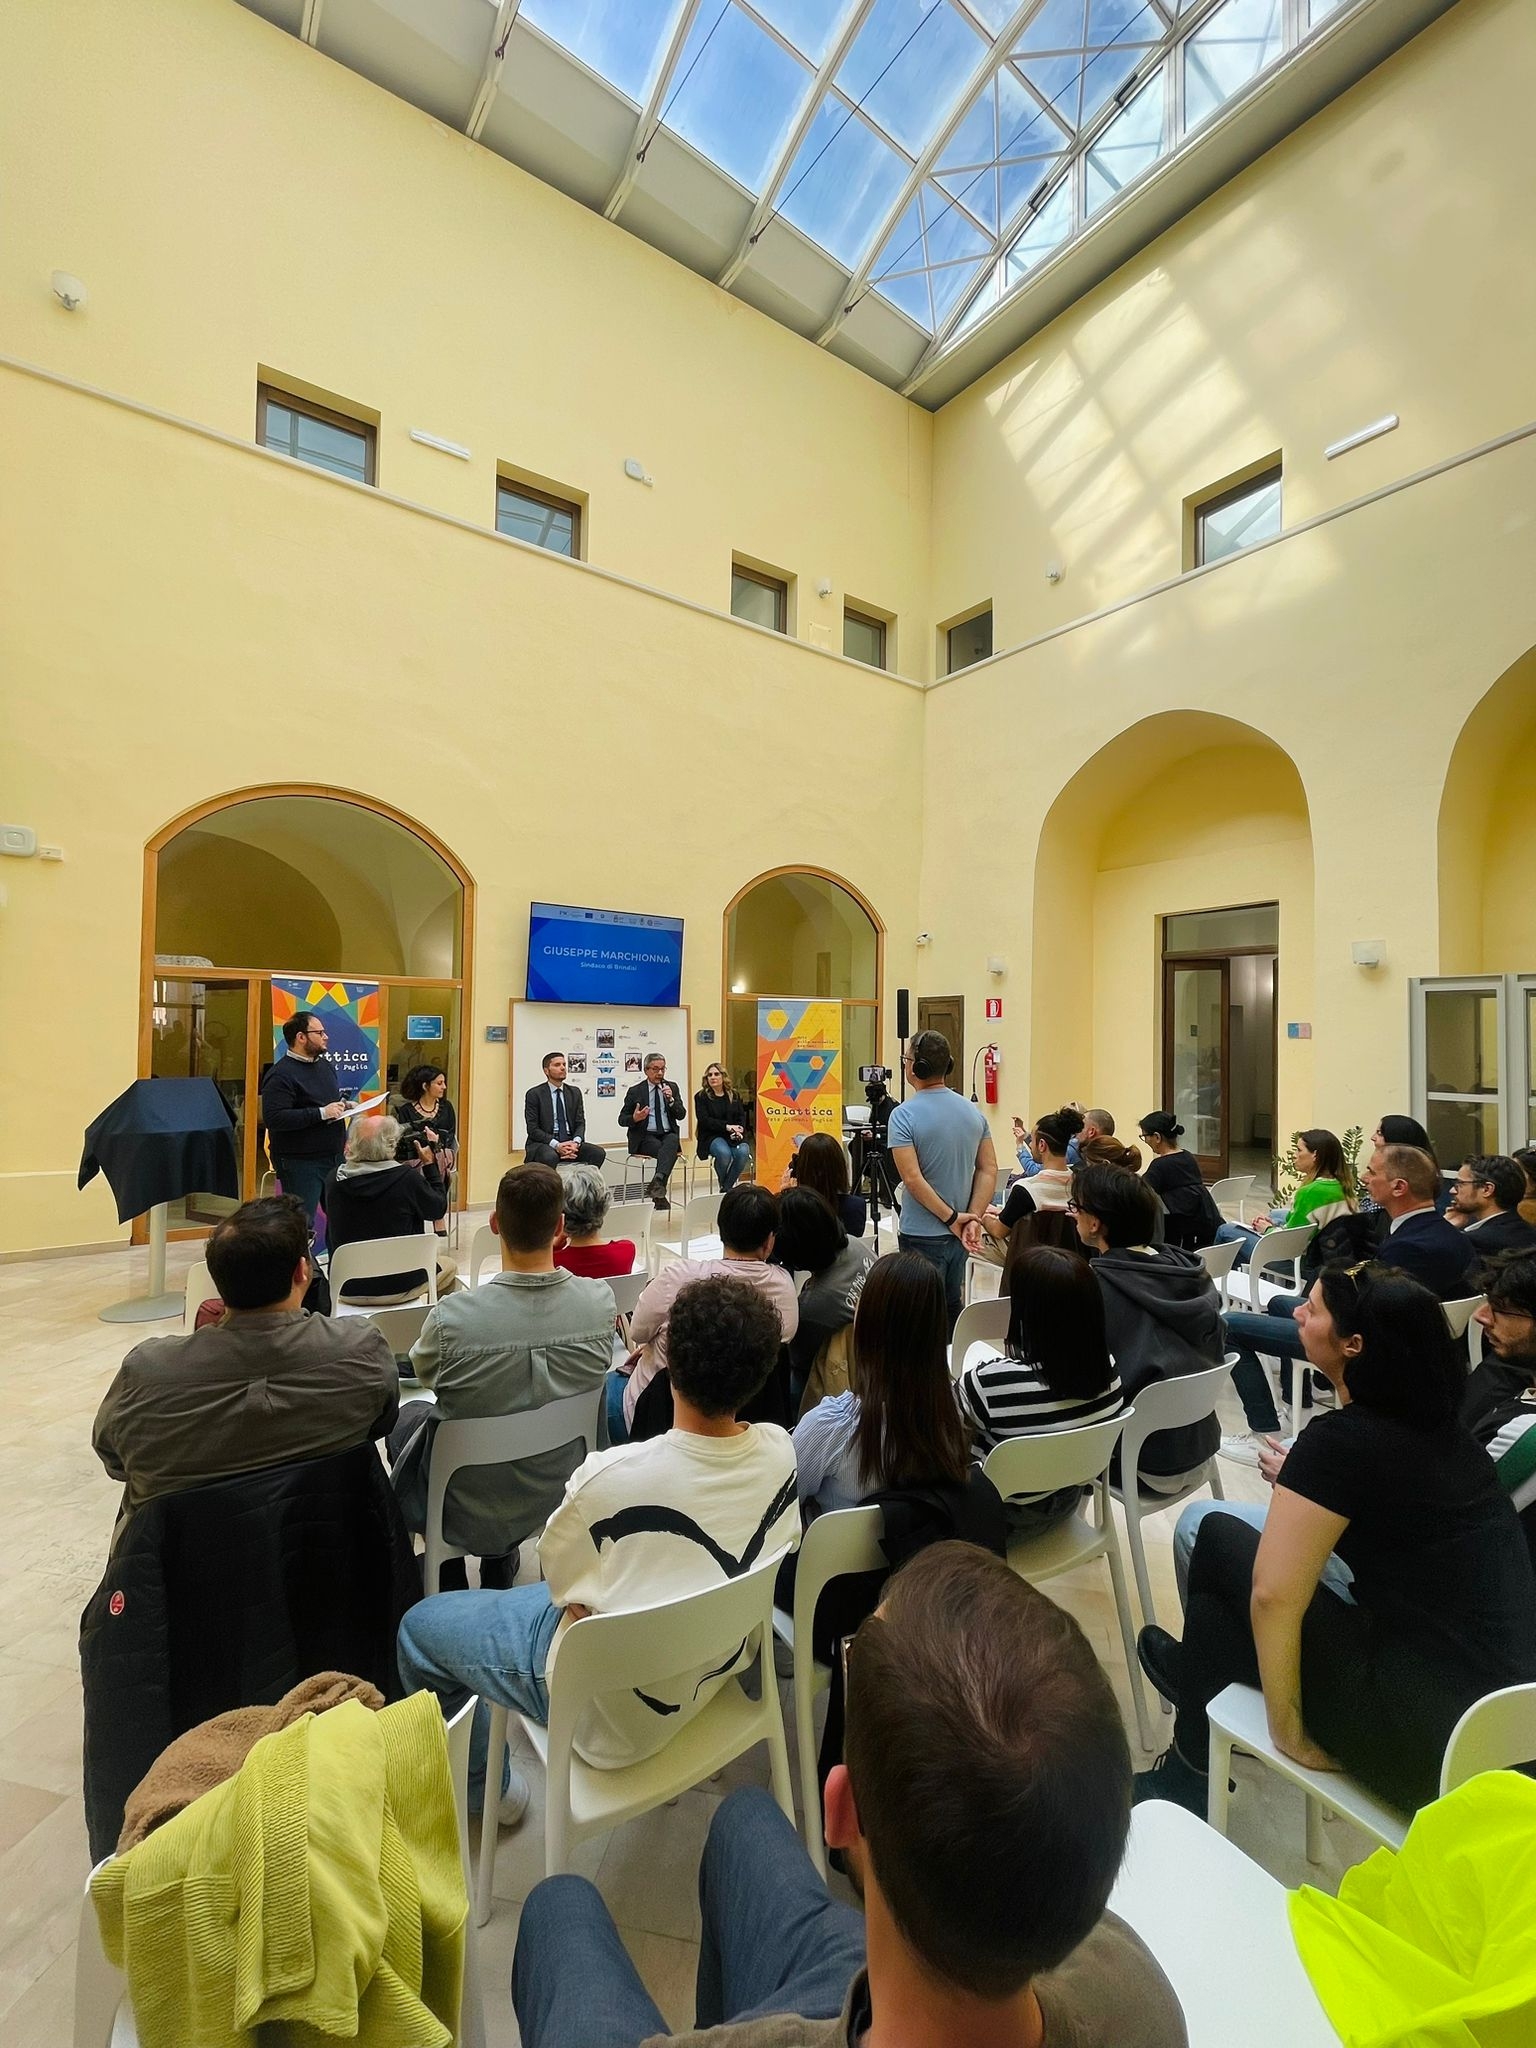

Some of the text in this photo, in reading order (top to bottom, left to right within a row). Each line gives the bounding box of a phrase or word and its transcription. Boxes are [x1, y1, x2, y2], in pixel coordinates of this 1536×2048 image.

[543, 946, 671, 964] GIUSEPPE MARCHIONNA
[580, 961, 606, 969] Sindaco
[343, 1063, 368, 1071] Puglia
[766, 1106, 833, 1116] Galattica
